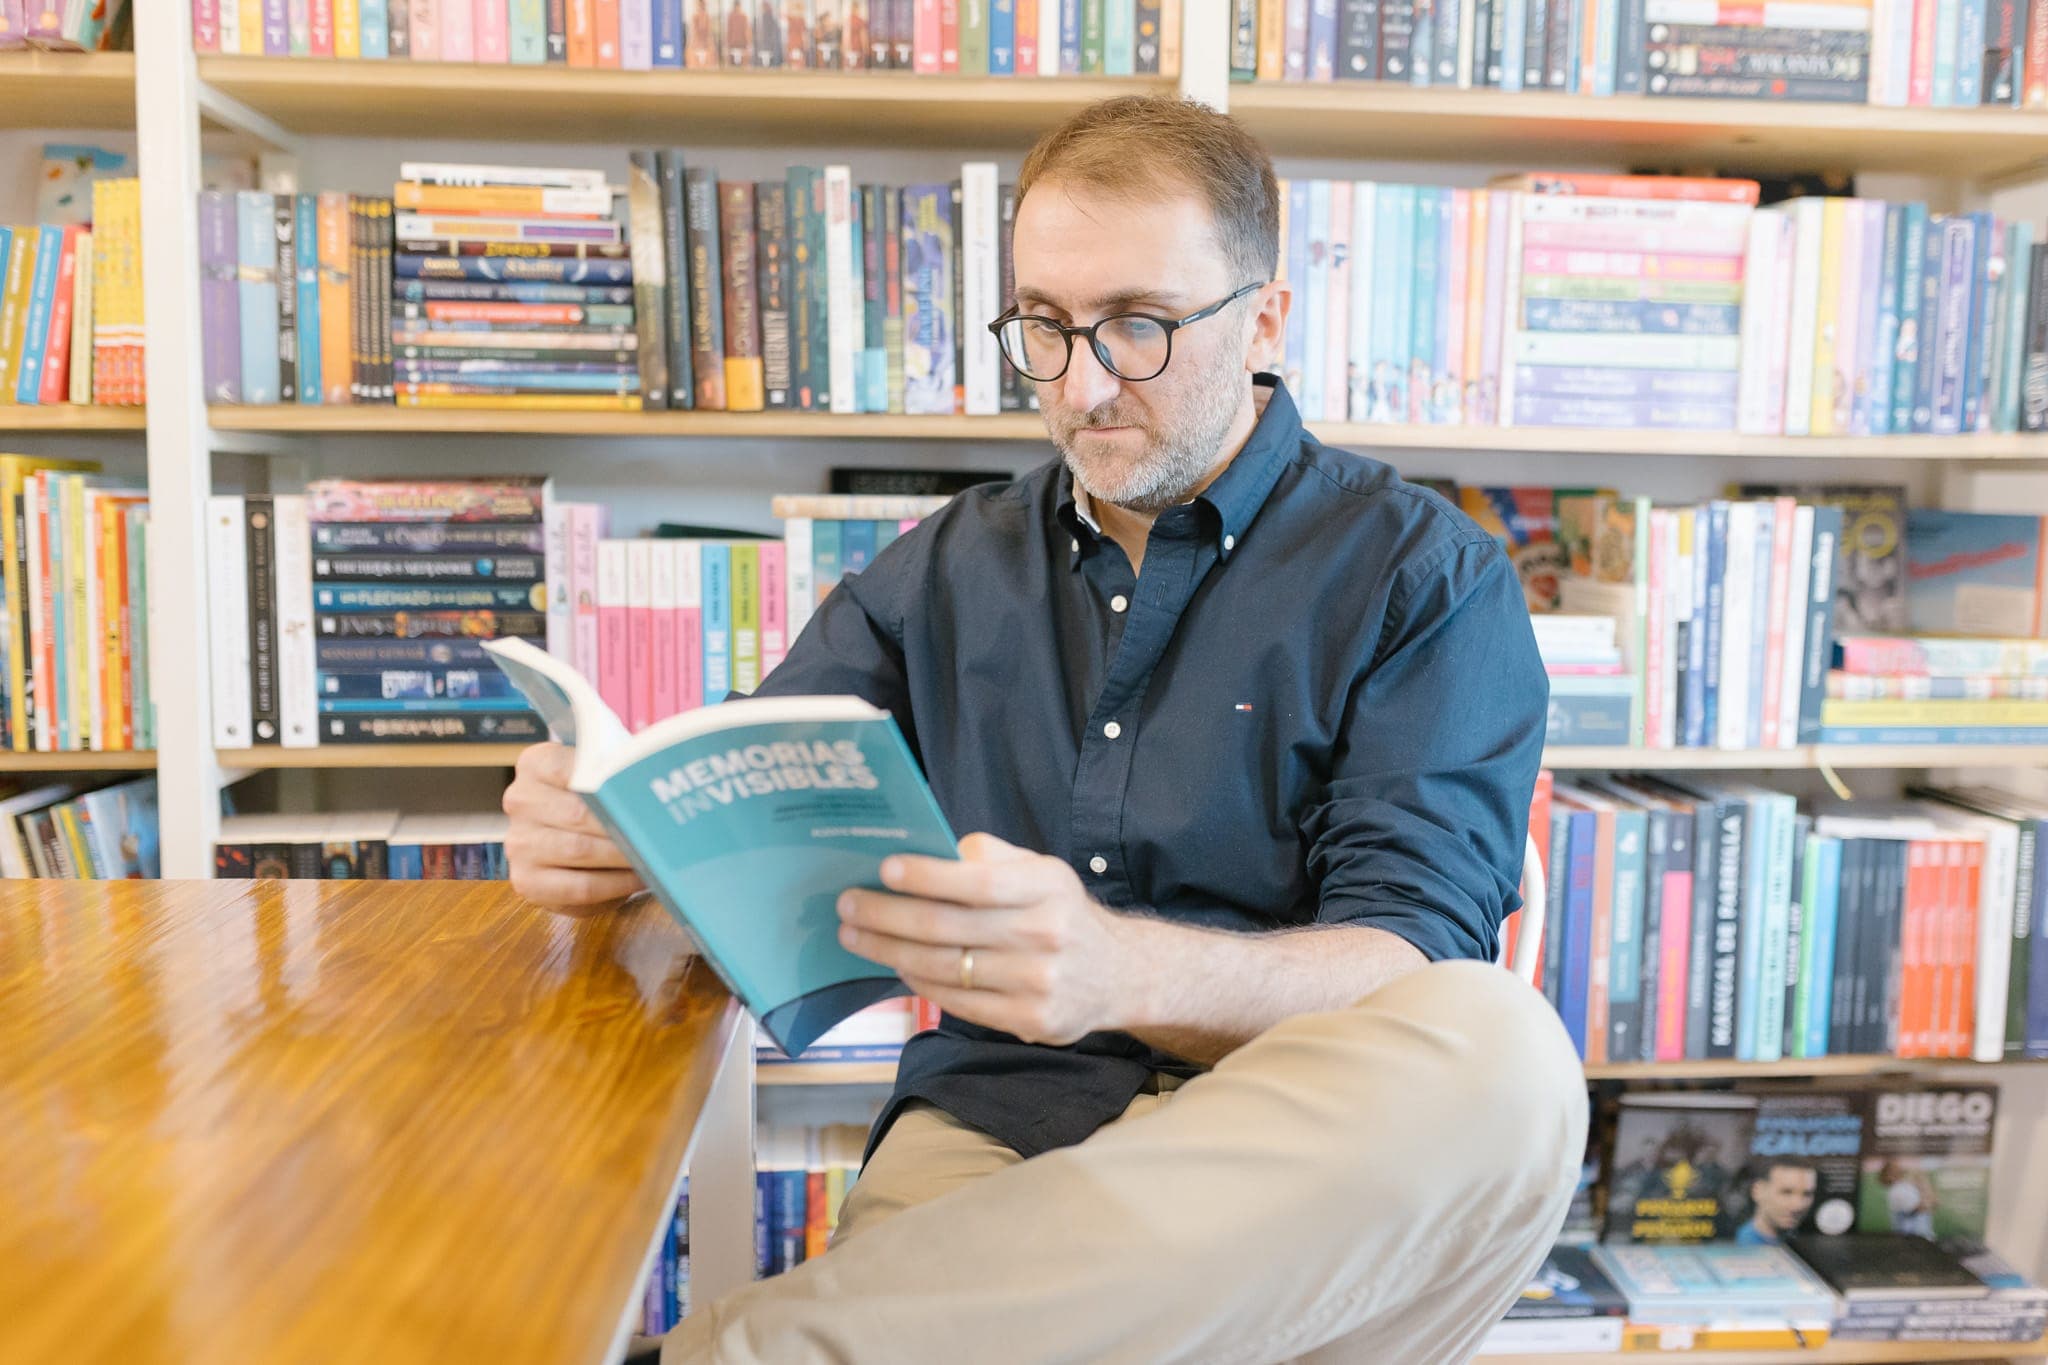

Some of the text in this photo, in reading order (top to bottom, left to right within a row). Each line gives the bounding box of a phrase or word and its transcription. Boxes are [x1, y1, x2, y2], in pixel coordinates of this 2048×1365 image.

[764, 310, 790, 389] FRATERNITY
[650, 739, 866, 804] MEMORIAS
[667, 764, 879, 826] INVISIBLES
[1711, 814, 1741, 1046] MANUAL DE PARRILLA
[1876, 1092, 1994, 1125] DIEGO
